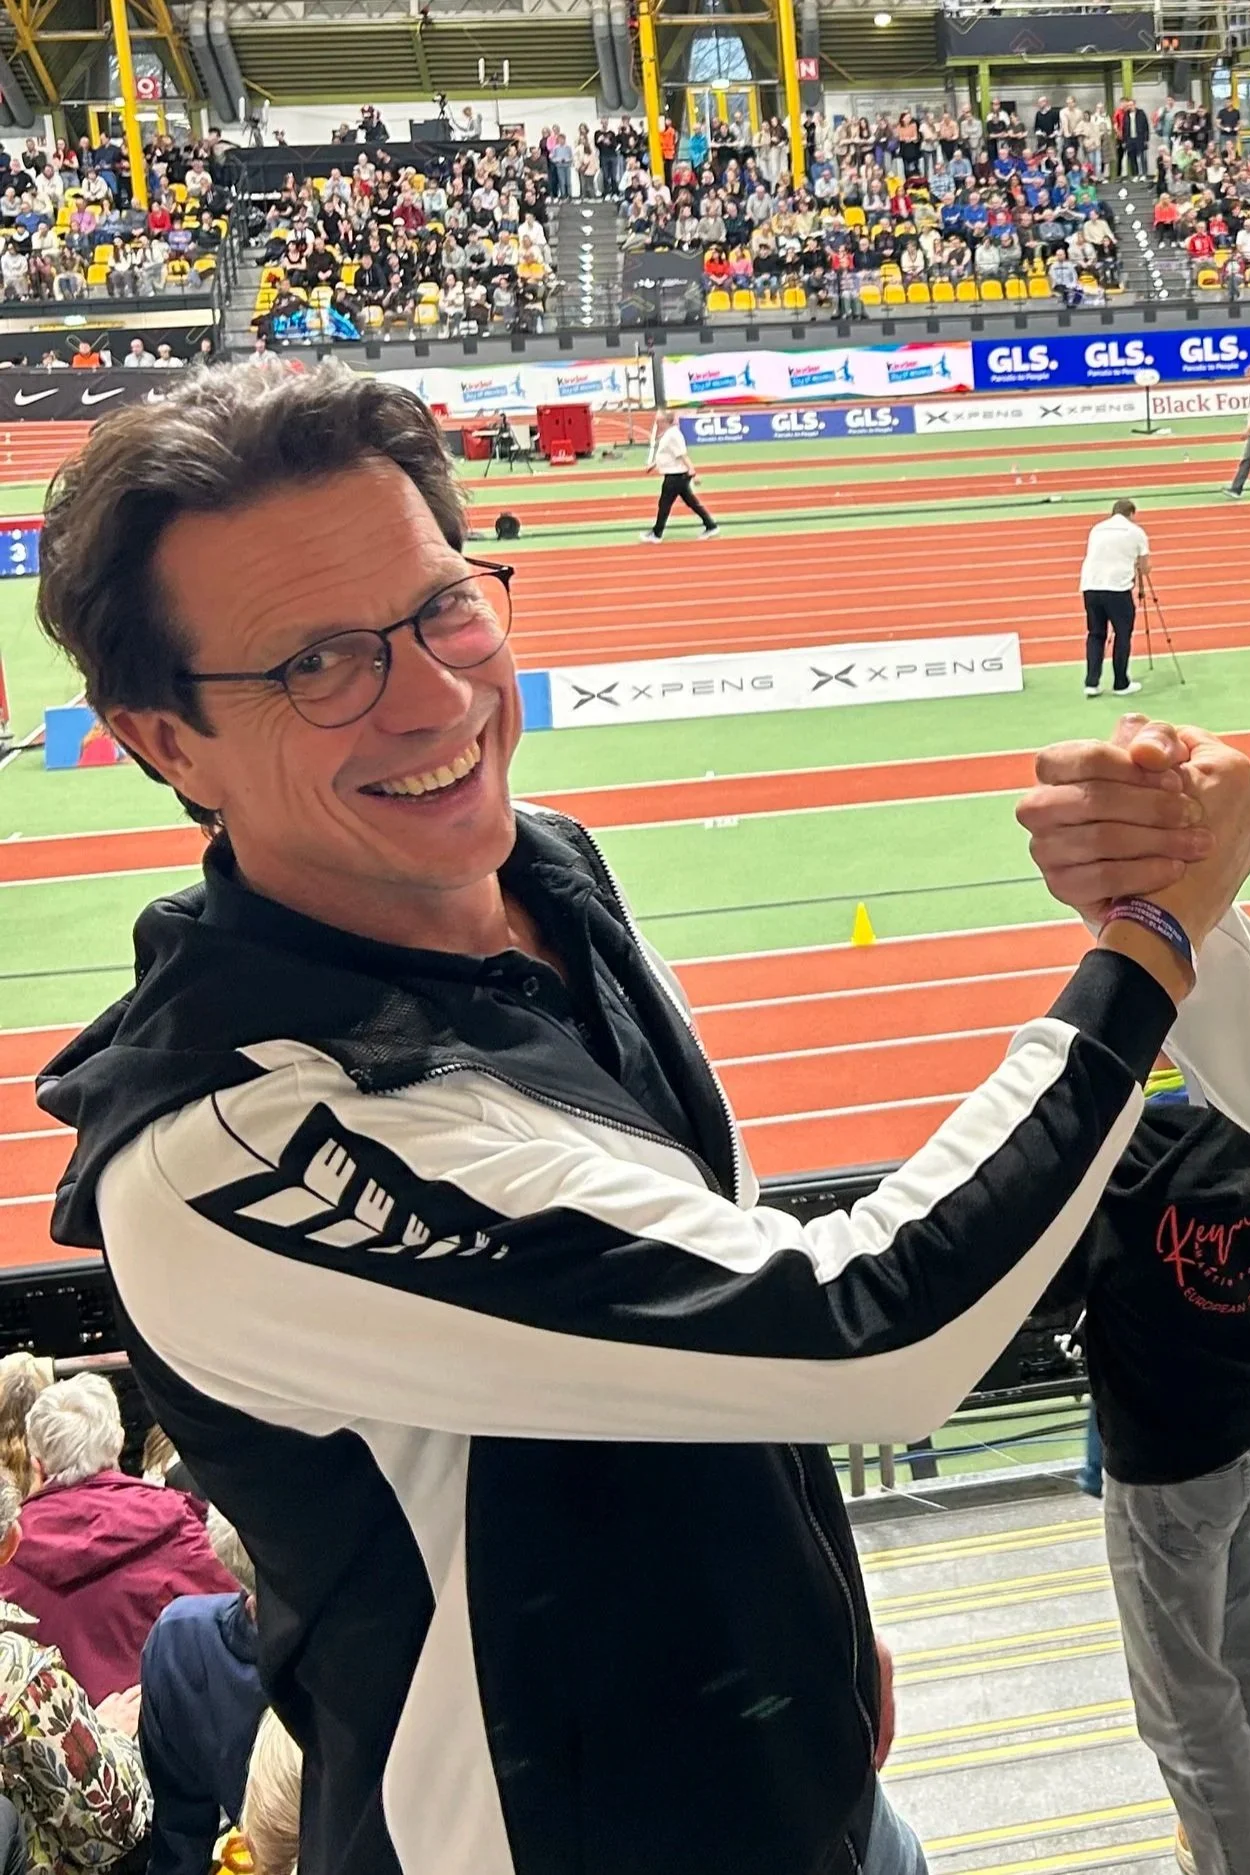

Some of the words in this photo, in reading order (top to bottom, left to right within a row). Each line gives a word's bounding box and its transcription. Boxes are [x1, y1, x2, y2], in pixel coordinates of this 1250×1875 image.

[800, 60, 816, 77] N
[987, 344, 1059, 373] GLS.
[1084, 340, 1155, 368] GLS.
[1180, 335, 1249, 363] GLS.
[1152, 395, 1211, 415] Black
[695, 415, 750, 436] GLS.
[771, 412, 826, 433] GLS.
[845, 408, 899, 429] GLS.
[868, 656, 1005, 683] XPENG
[631, 675, 775, 701] XPENG
